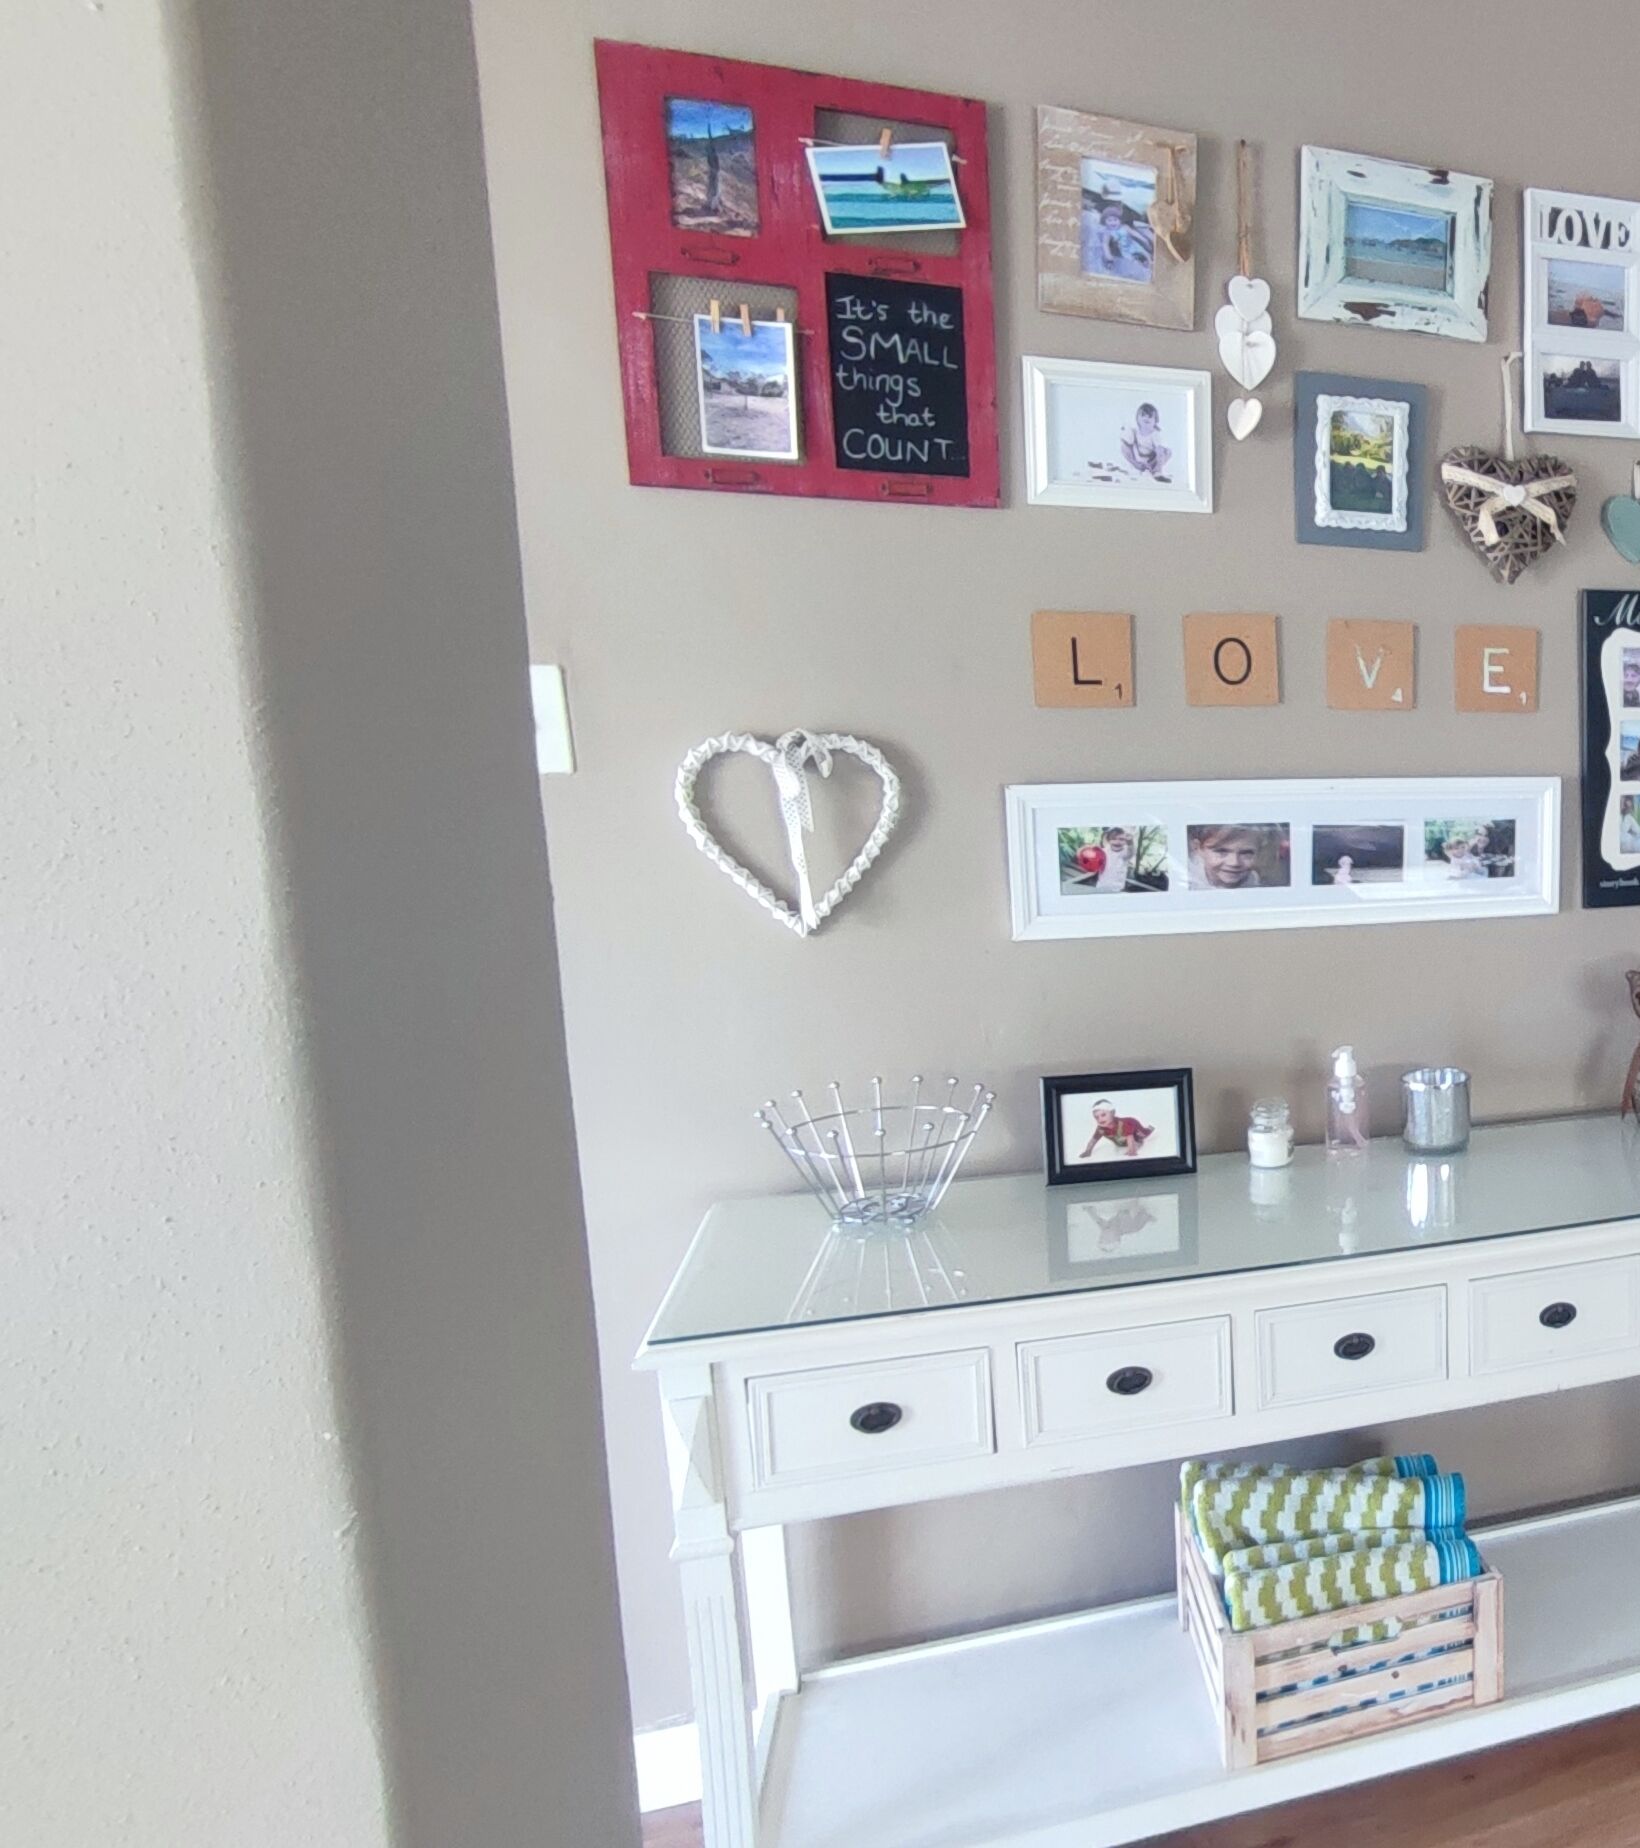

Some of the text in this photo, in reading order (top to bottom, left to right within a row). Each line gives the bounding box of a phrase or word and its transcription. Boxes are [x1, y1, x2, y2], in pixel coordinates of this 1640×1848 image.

[1537, 205, 1632, 252] LOVE
[835, 295, 955, 330] It's the
[840, 325, 959, 370] SMALL
[835, 363, 922, 408] things
[876, 404, 936, 428] that
